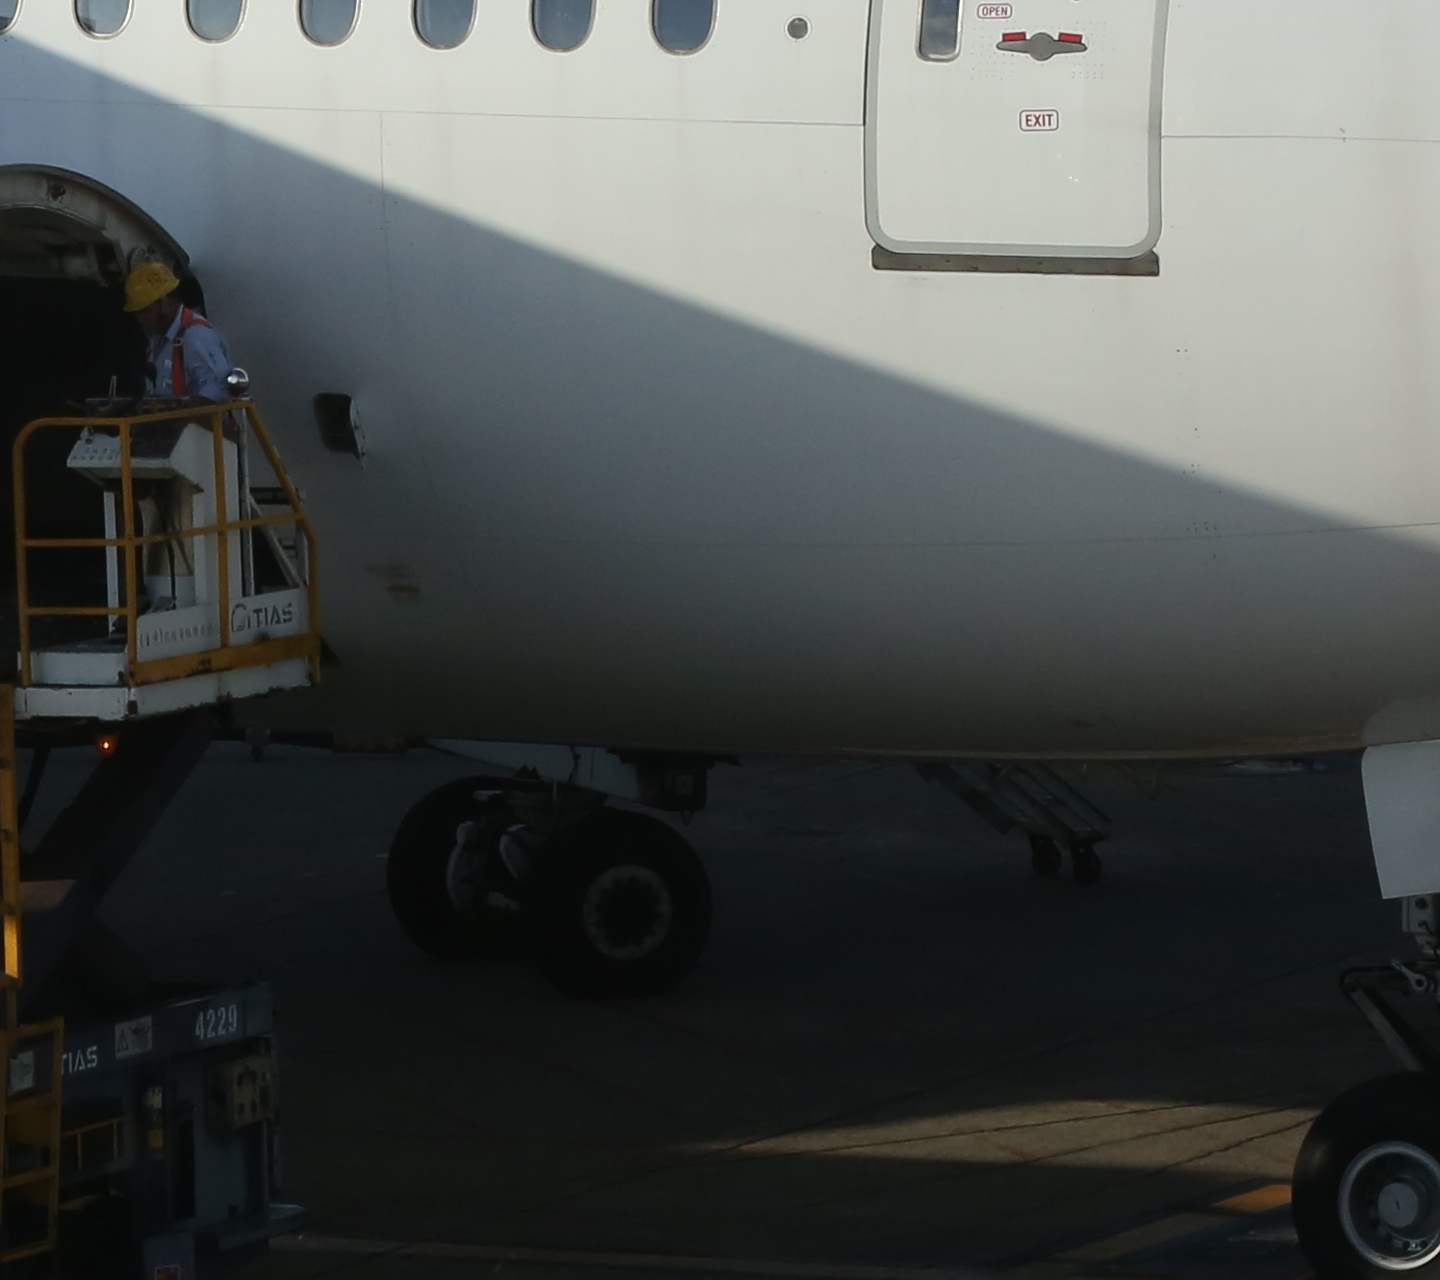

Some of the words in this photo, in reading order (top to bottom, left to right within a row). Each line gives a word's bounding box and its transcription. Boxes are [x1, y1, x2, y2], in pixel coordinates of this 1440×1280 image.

[981, 6, 1008, 17] OPEN
[1025, 113, 1054, 127] EXIT
[253, 602, 293, 628] TIAS
[194, 1004, 238, 1041] 4229
